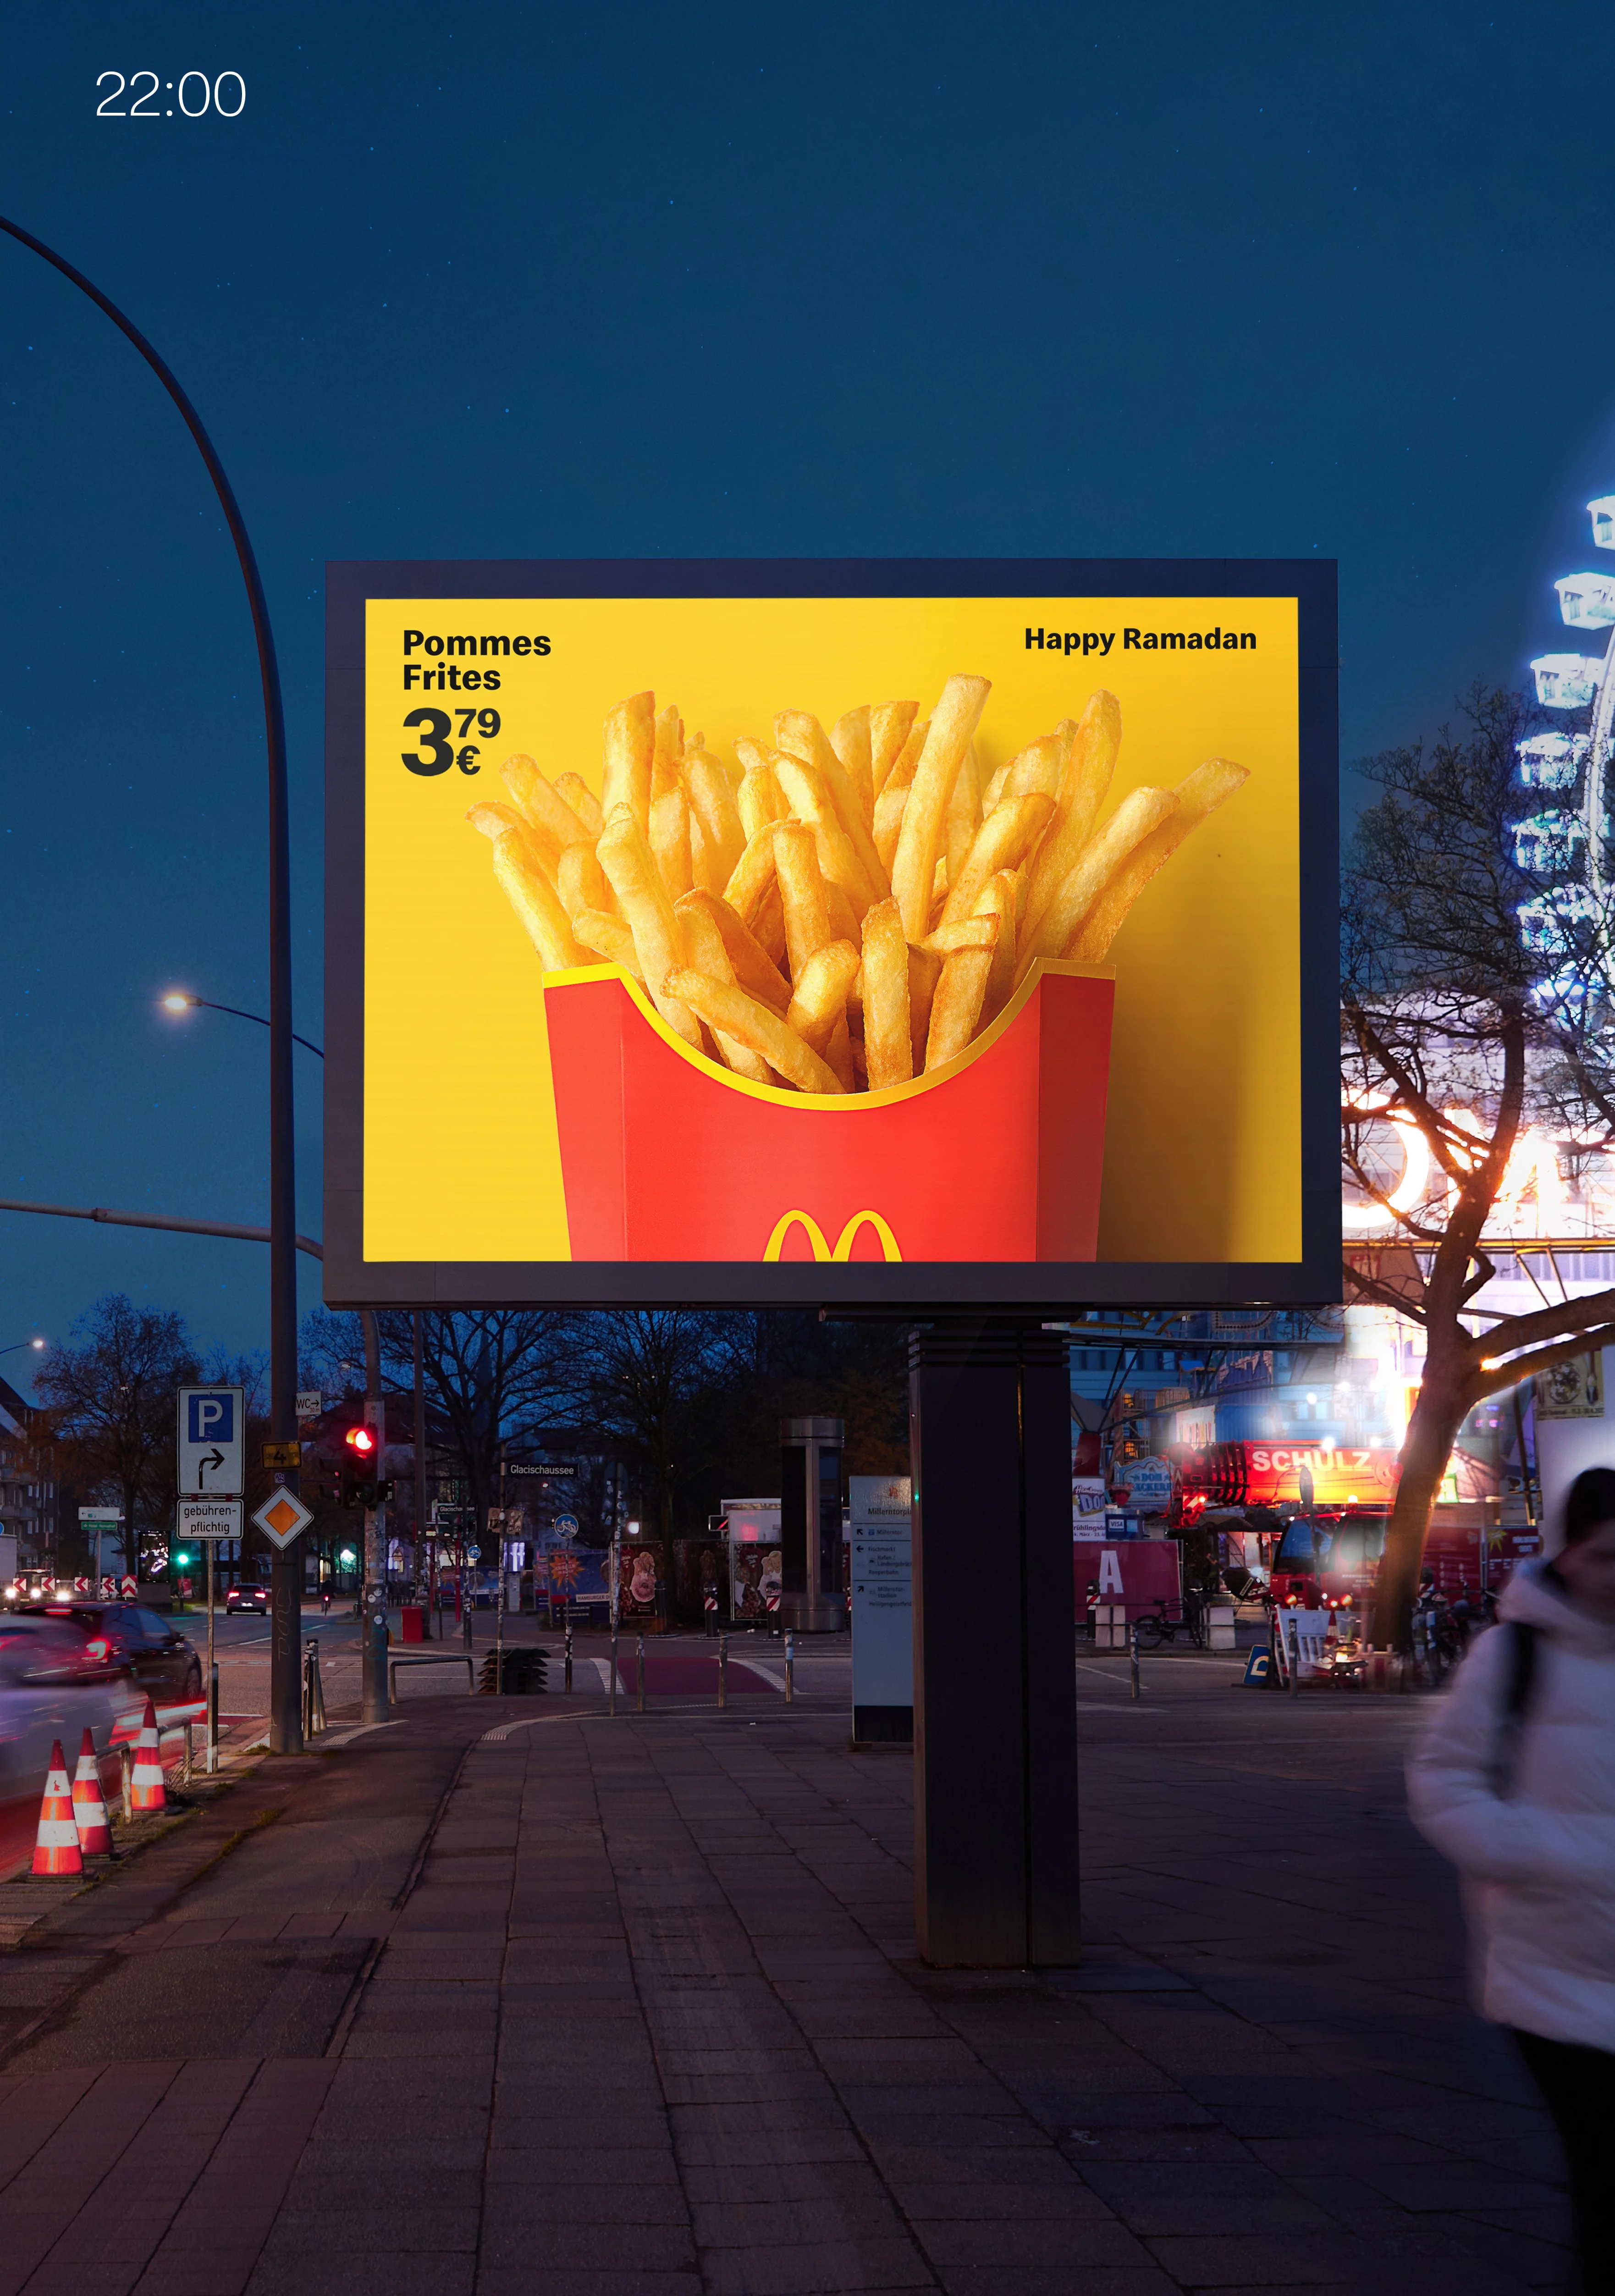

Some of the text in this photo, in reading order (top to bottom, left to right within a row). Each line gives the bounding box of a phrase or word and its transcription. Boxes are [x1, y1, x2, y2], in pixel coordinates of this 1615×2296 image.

[404, 630, 551, 656] Pommes
[1025, 627, 1257, 656] Happy Ramadan
[404, 662, 501, 690] Frites
[297, 1398, 310, 1409] WC
[198, 1399, 223, 1438] P
[273, 1447, 287, 1465] 4
[1252, 1450, 1374, 1473] SCHULZ
[510, 1464, 574, 1475] Glacischaussee
[184, 1505, 237, 1518] gebühren-
[191, 1521, 230, 1535] pflichtig
